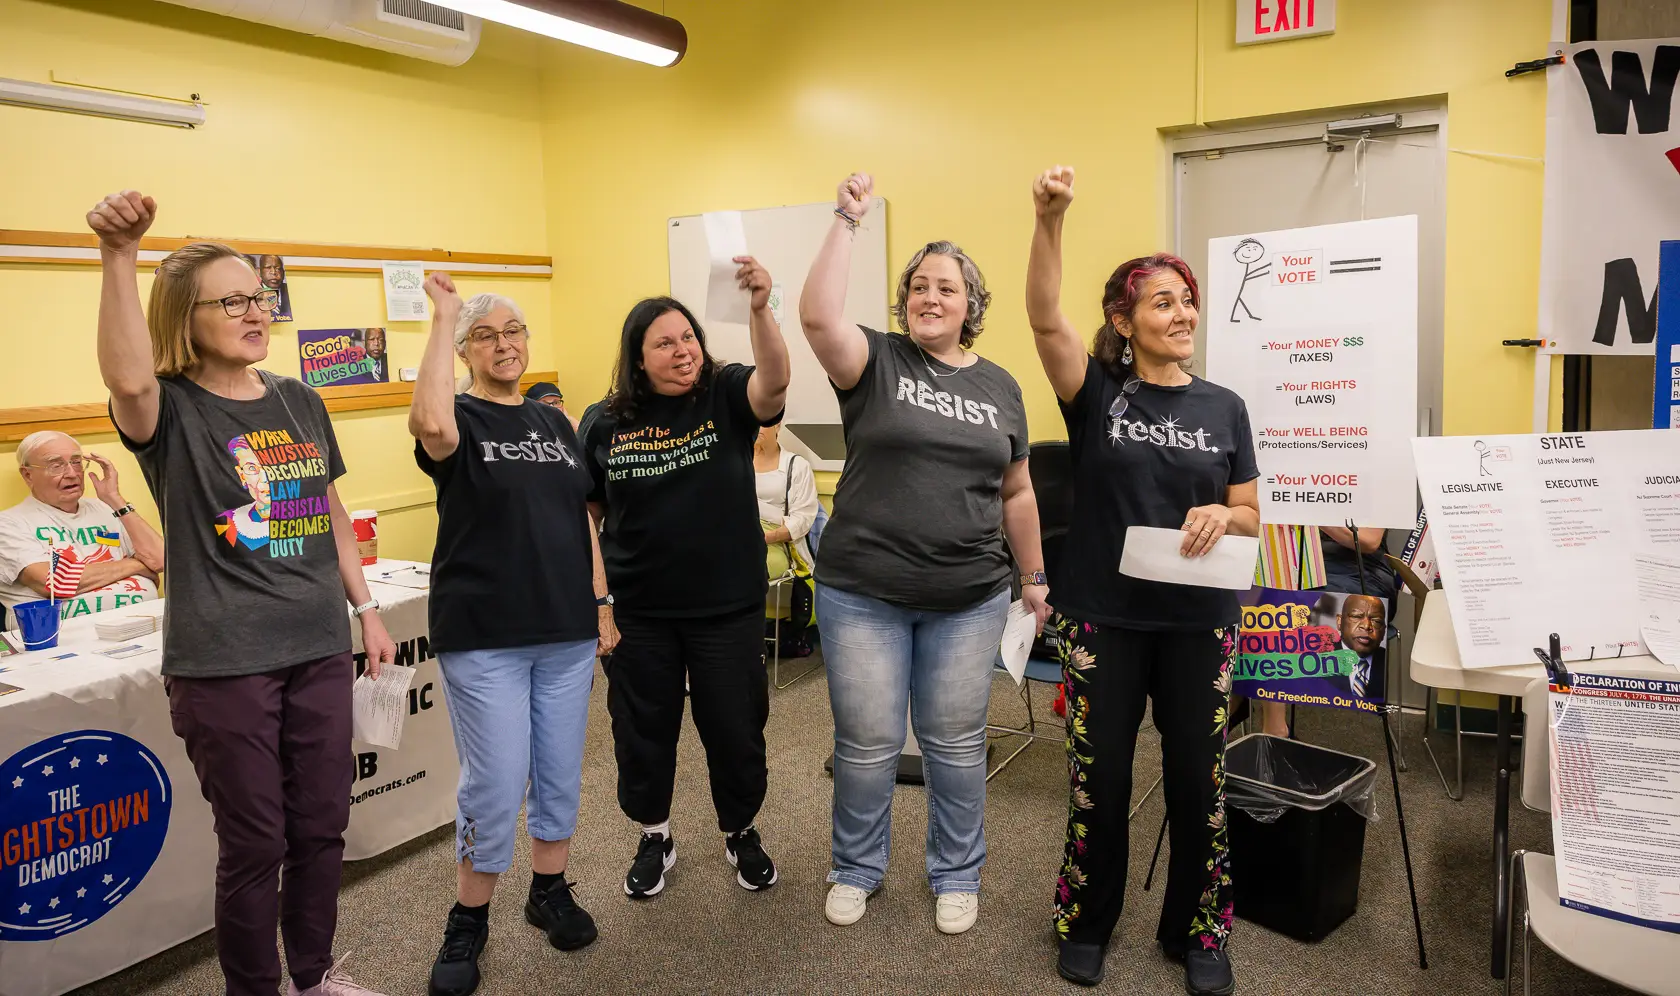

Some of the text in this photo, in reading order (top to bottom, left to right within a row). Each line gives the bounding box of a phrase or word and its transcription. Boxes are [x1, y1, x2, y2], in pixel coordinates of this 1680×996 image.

[1282, 255, 1313, 266] Your
[1278, 271, 1316, 284] VOTE
[304, 337, 343, 357] Good
[1295, 338, 1340, 349] MONEY
[306, 349, 357, 371] Trouble
[1289, 352, 1333, 364] (TAXES)
[310, 361, 368, 384] Lives On
[1311, 380, 1357, 391] RIGHTS
[897, 375, 998, 430] RESIST
[1295, 394, 1336, 406] (LAWS)
[244, 429, 295, 450] WHEN
[610, 420, 714, 456] remembered as a
[618, 427, 654, 442] won't
[655, 427, 671, 438] be
[1293, 427, 1326, 437] WELL
[1329, 426, 1368, 436] BEING
[607, 432, 719, 466] woman who kept
[1258, 440, 1368, 450] (Protections/Services)
[1541, 436, 1586, 450] STATE
[253, 442, 321, 465] INJUSTICE
[263, 458, 326, 482] BECOMES
[608, 449, 710, 481] her mouth shut
[269, 479, 300, 501] LAW
[1310, 474, 1358, 486] VOICE
[1441, 482, 1504, 494] LEGISLATIVE
[1545, 478, 1600, 489] EXECUTIVE
[1271, 491, 1353, 504] BE HEARD!
[36, 525, 107, 545] CYM
[269, 514, 330, 539] BECOMES
[269, 537, 304, 558] DUTY
[1407, 537, 1418, 548] OF
[1402, 548, 1413, 566] ILL
[1240, 606, 1293, 629] ood
[1239, 629, 1321, 654] rouble
[1299, 652, 1340, 676] On
[1573, 675, 1646, 690] DECLARATION
[1648, 681, 1663, 691] OF
[1574, 689, 1608, 697] CONGRESS
[1256, 687, 1276, 699] Our
[1277, 690, 1330, 705] Freedoms.
[1333, 696, 1353, 707] Our
[1590, 698, 1622, 707] THIRTEEN
[1625, 700, 1656, 710] UNITED
[48, 784, 81, 814] THE
[0, 789, 149, 871] GHTSTOWN
[18, 837, 113, 888] DEMOCRAT
